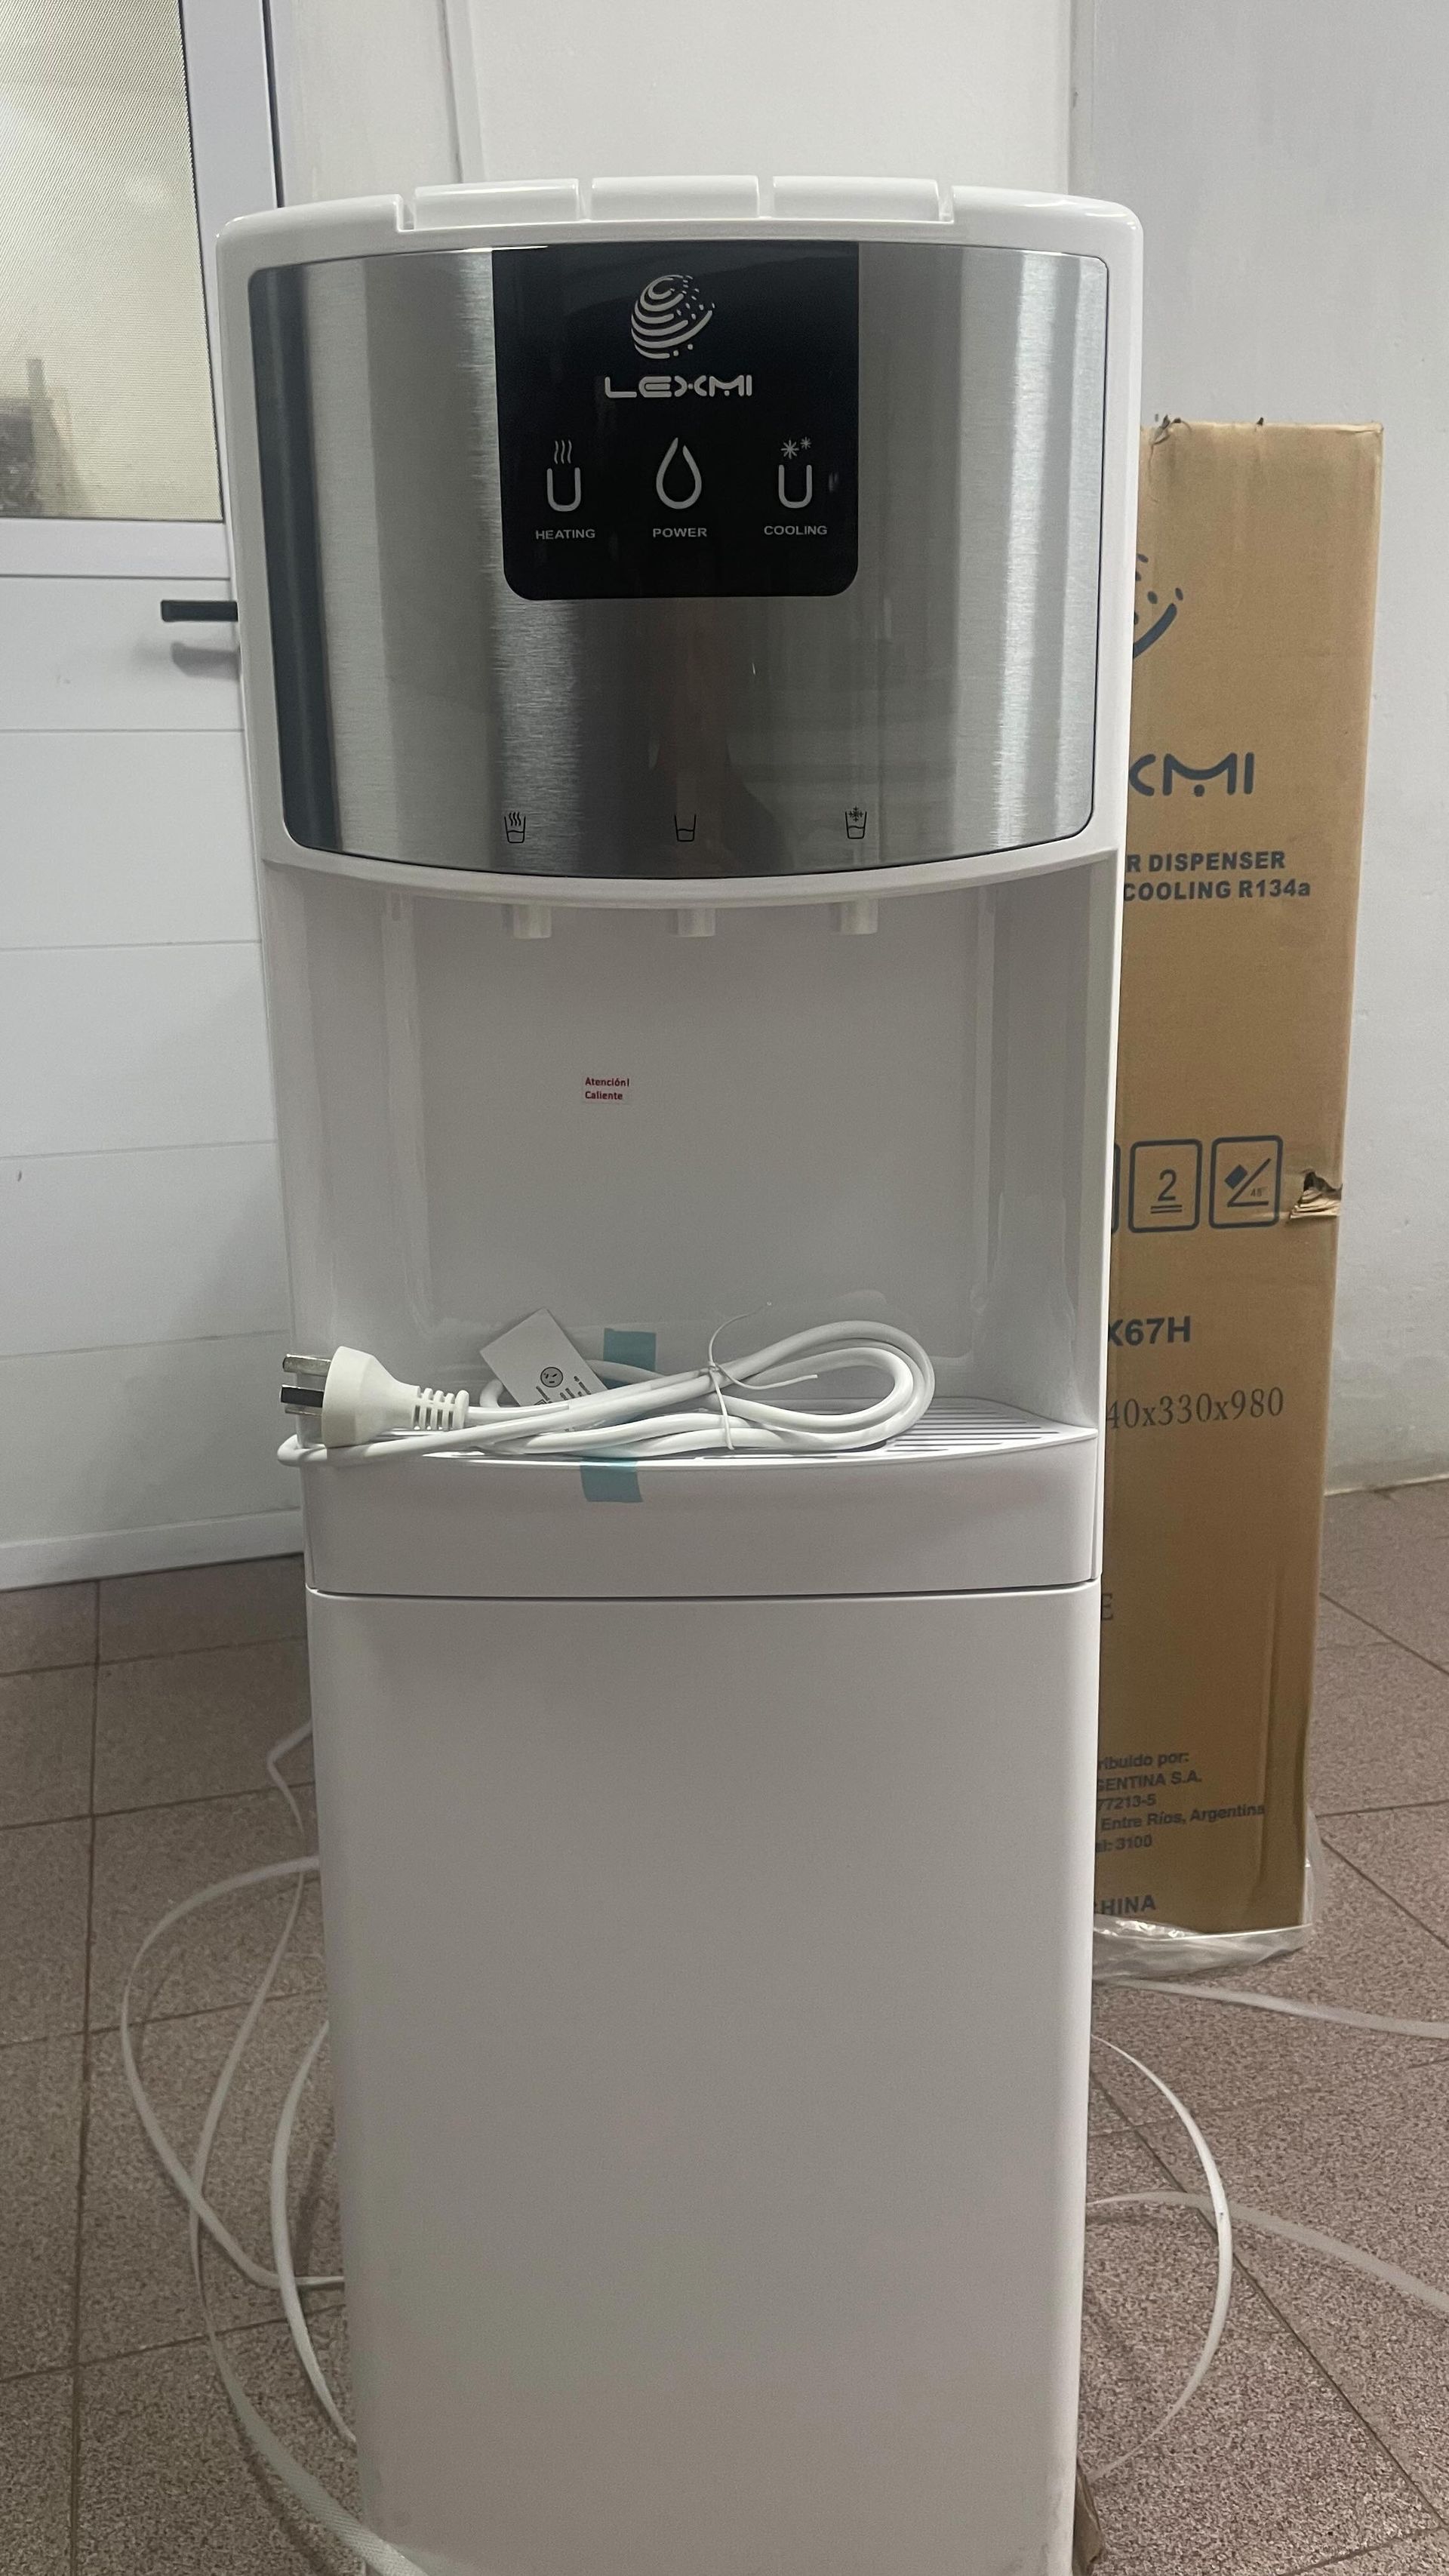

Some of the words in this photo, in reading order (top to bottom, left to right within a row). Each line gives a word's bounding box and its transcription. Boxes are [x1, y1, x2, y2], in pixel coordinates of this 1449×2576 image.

[604, 374, 753, 399] LEXMI
[535, 528, 596, 540] HEATING
[653, 528, 708, 538] POWER
[764, 525, 828, 536] COOLING
[1149, 850, 1286, 872] DISPENSER
[1123, 881, 1232, 901] COOLING
[1238, 879, 1311, 899] R134a
[585, 1091, 623, 1100] Caliente
[1157, 1168, 1177, 1202] 2
[1106, 1386, 1284, 1429] 40x330x980
[1158, 1752, 1190, 1767] por:
[1171, 1769, 1202, 1784] S.A.
[1101, 1816, 1142, 1833] Entre
[1189, 1803, 1266, 1823] Argentina
[1115, 1834, 1153, 1850] 3100
[1094, 1894, 1156, 1916] HINA
